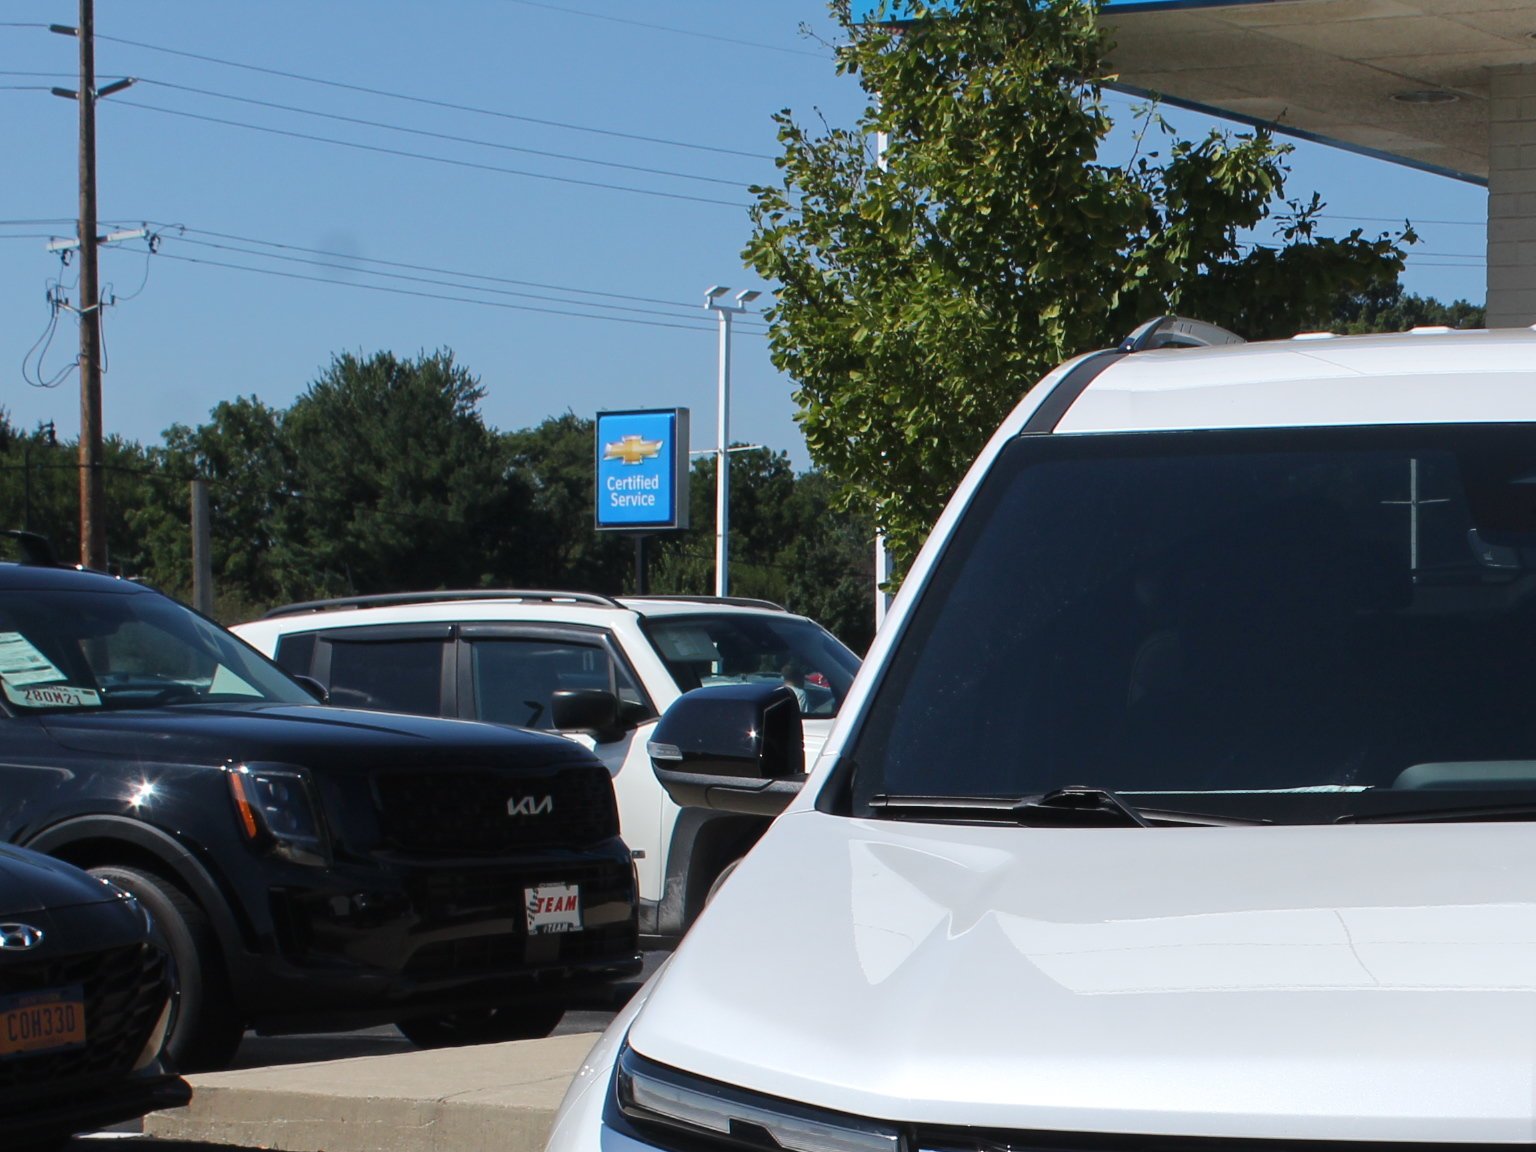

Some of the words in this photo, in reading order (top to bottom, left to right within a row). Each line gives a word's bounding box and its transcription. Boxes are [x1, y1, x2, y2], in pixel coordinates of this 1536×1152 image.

[607, 474, 659, 491] Certified
[611, 492, 656, 507] Service
[507, 795, 553, 816] KIA
[536, 895, 577, 914] TEAM
